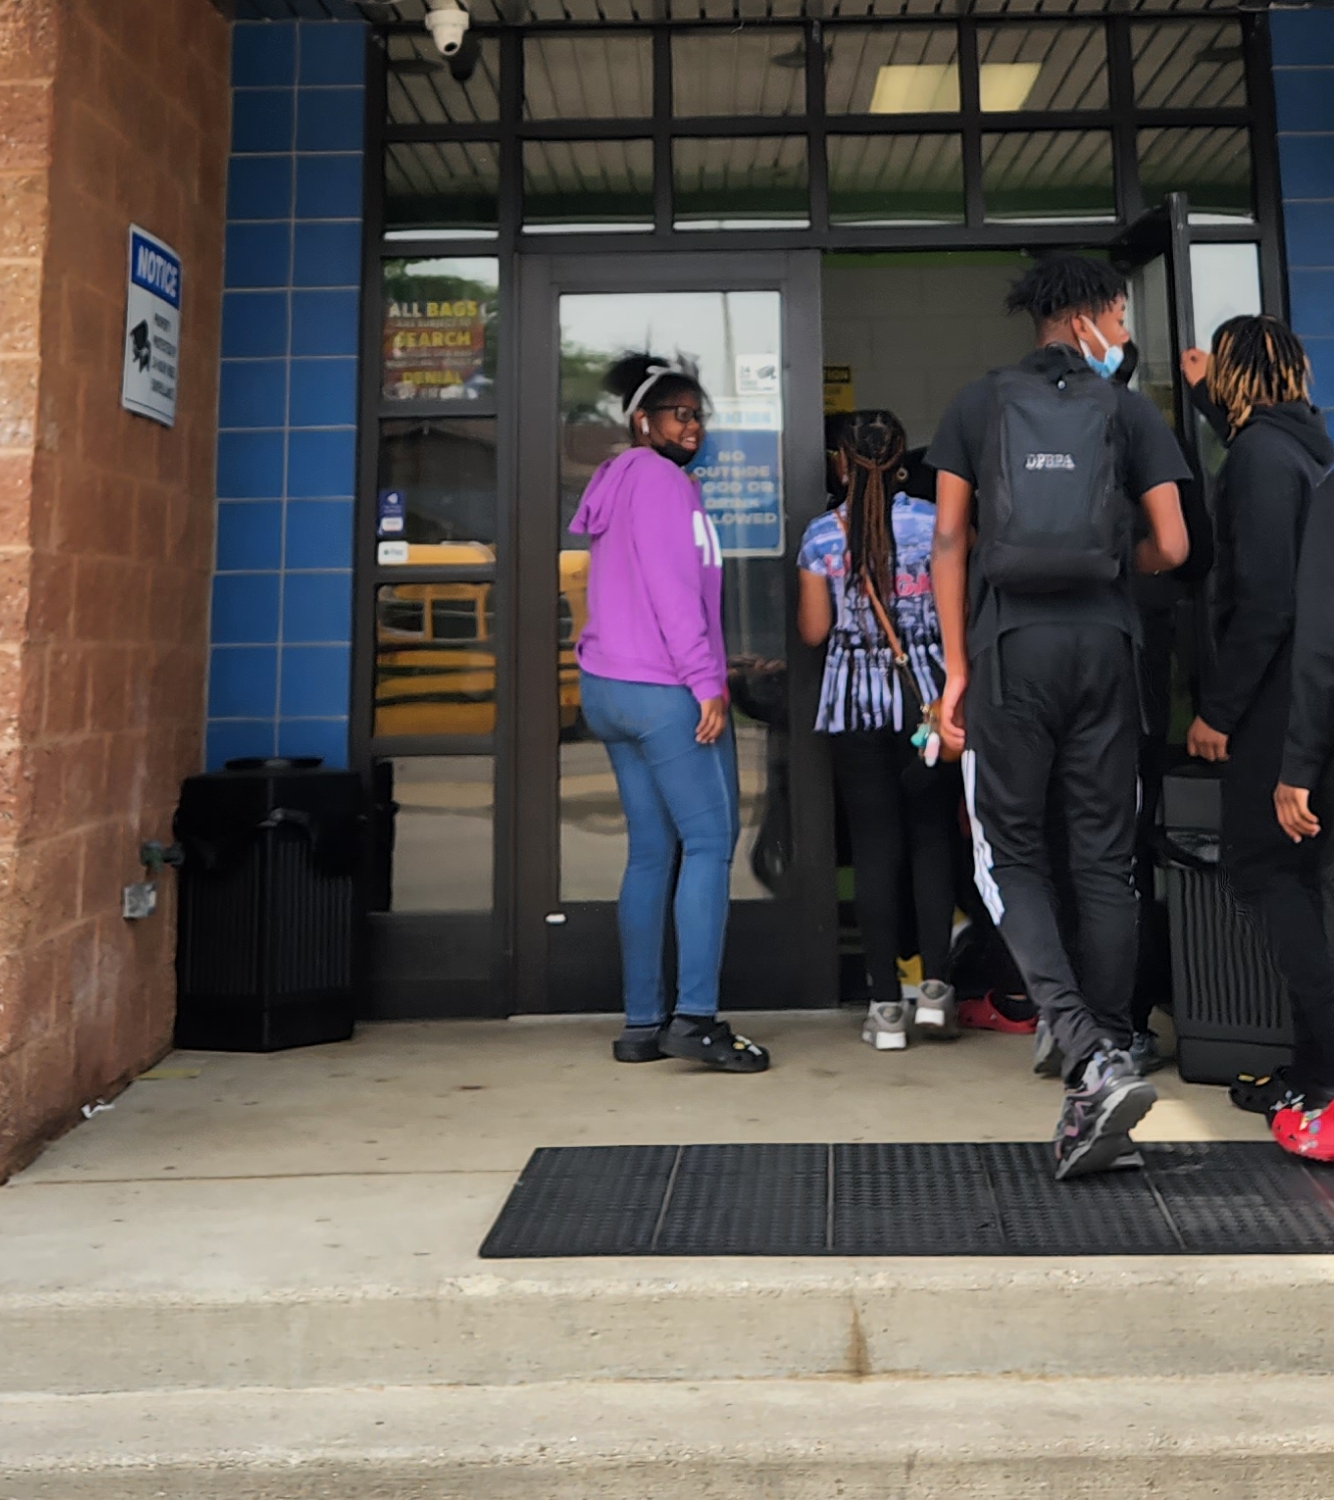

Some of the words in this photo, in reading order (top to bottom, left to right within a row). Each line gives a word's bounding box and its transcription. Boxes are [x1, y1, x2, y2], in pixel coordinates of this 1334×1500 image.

[137, 245, 178, 298] NOTICE
[389, 302, 422, 318] ALL
[426, 300, 478, 317] BAGS
[394, 331, 471, 348] SEARCH
[718, 450, 745, 463] NO
[693, 465, 770, 478] OUTSIDE
[701, 481, 743, 494] OOD
[747, 481, 775, 494] OR
[712, 512, 778, 525] LOWED
